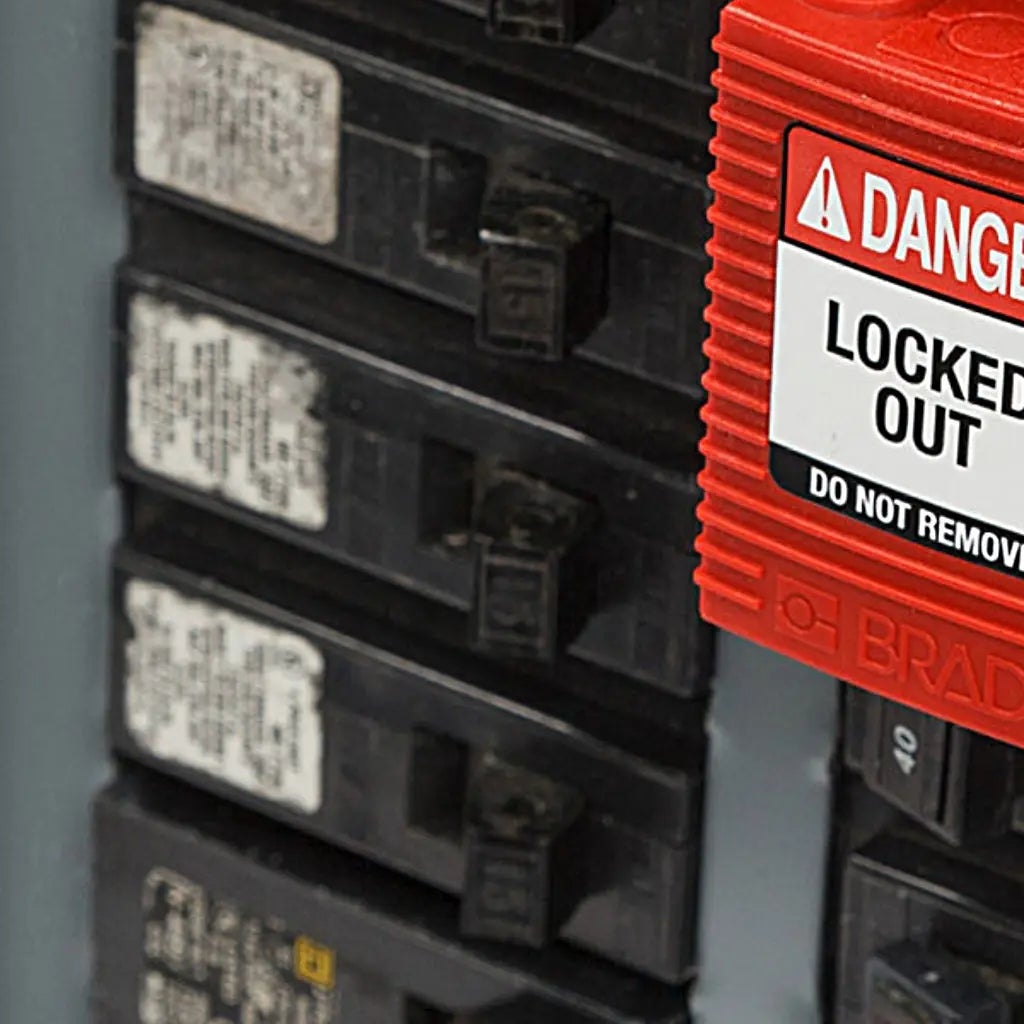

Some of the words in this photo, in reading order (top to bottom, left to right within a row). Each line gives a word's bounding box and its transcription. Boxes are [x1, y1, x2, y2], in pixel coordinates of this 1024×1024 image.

[875, 385, 983, 469] OUT
[809, 466, 848, 507] DO
[854, 484, 912, 531] NOT
[892, 725, 918, 775] 40
